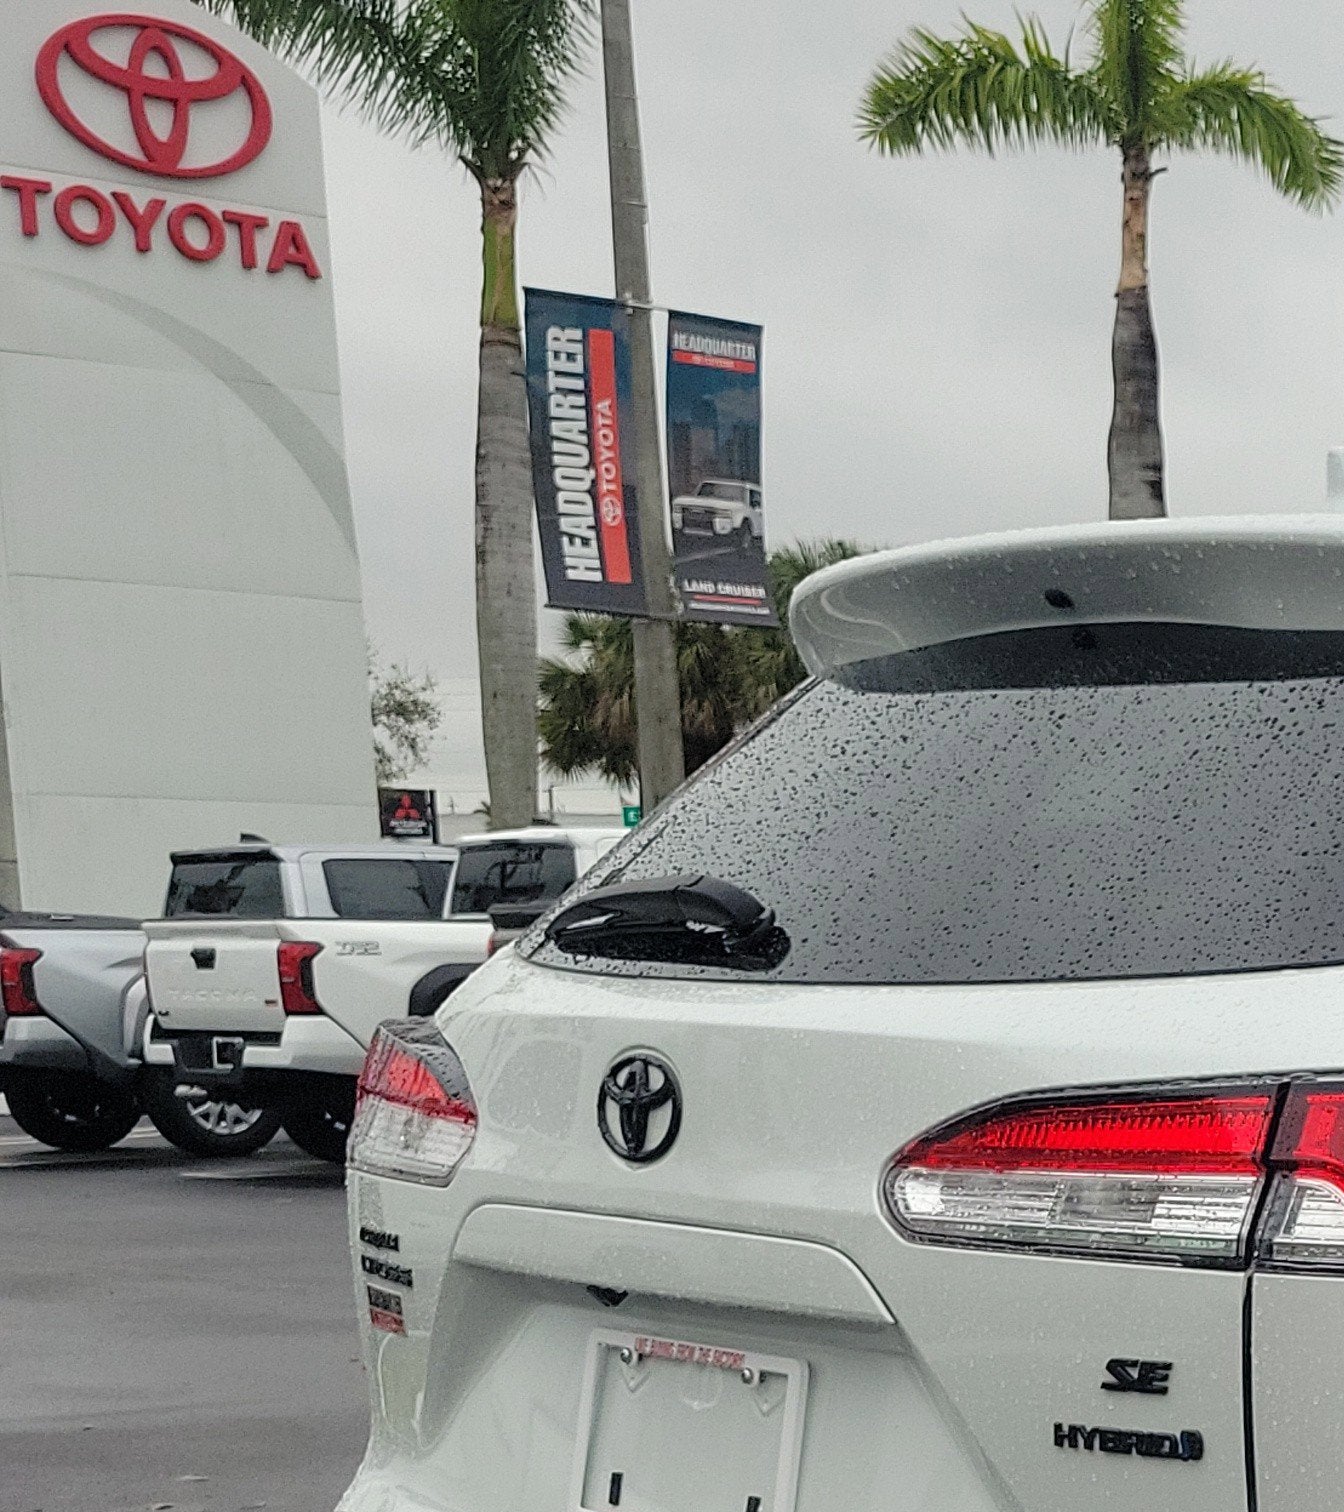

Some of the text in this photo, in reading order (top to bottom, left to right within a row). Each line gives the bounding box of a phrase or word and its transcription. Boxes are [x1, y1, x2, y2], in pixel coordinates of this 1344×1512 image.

[1, 175, 322, 280] TOYOTA
[546, 325, 603, 582] HEADQUARTER
[595, 399, 618, 494] TOYOTA
[1100, 1358, 1173, 1395] SE
[1053, 1421, 1181, 1460] HYBRID
